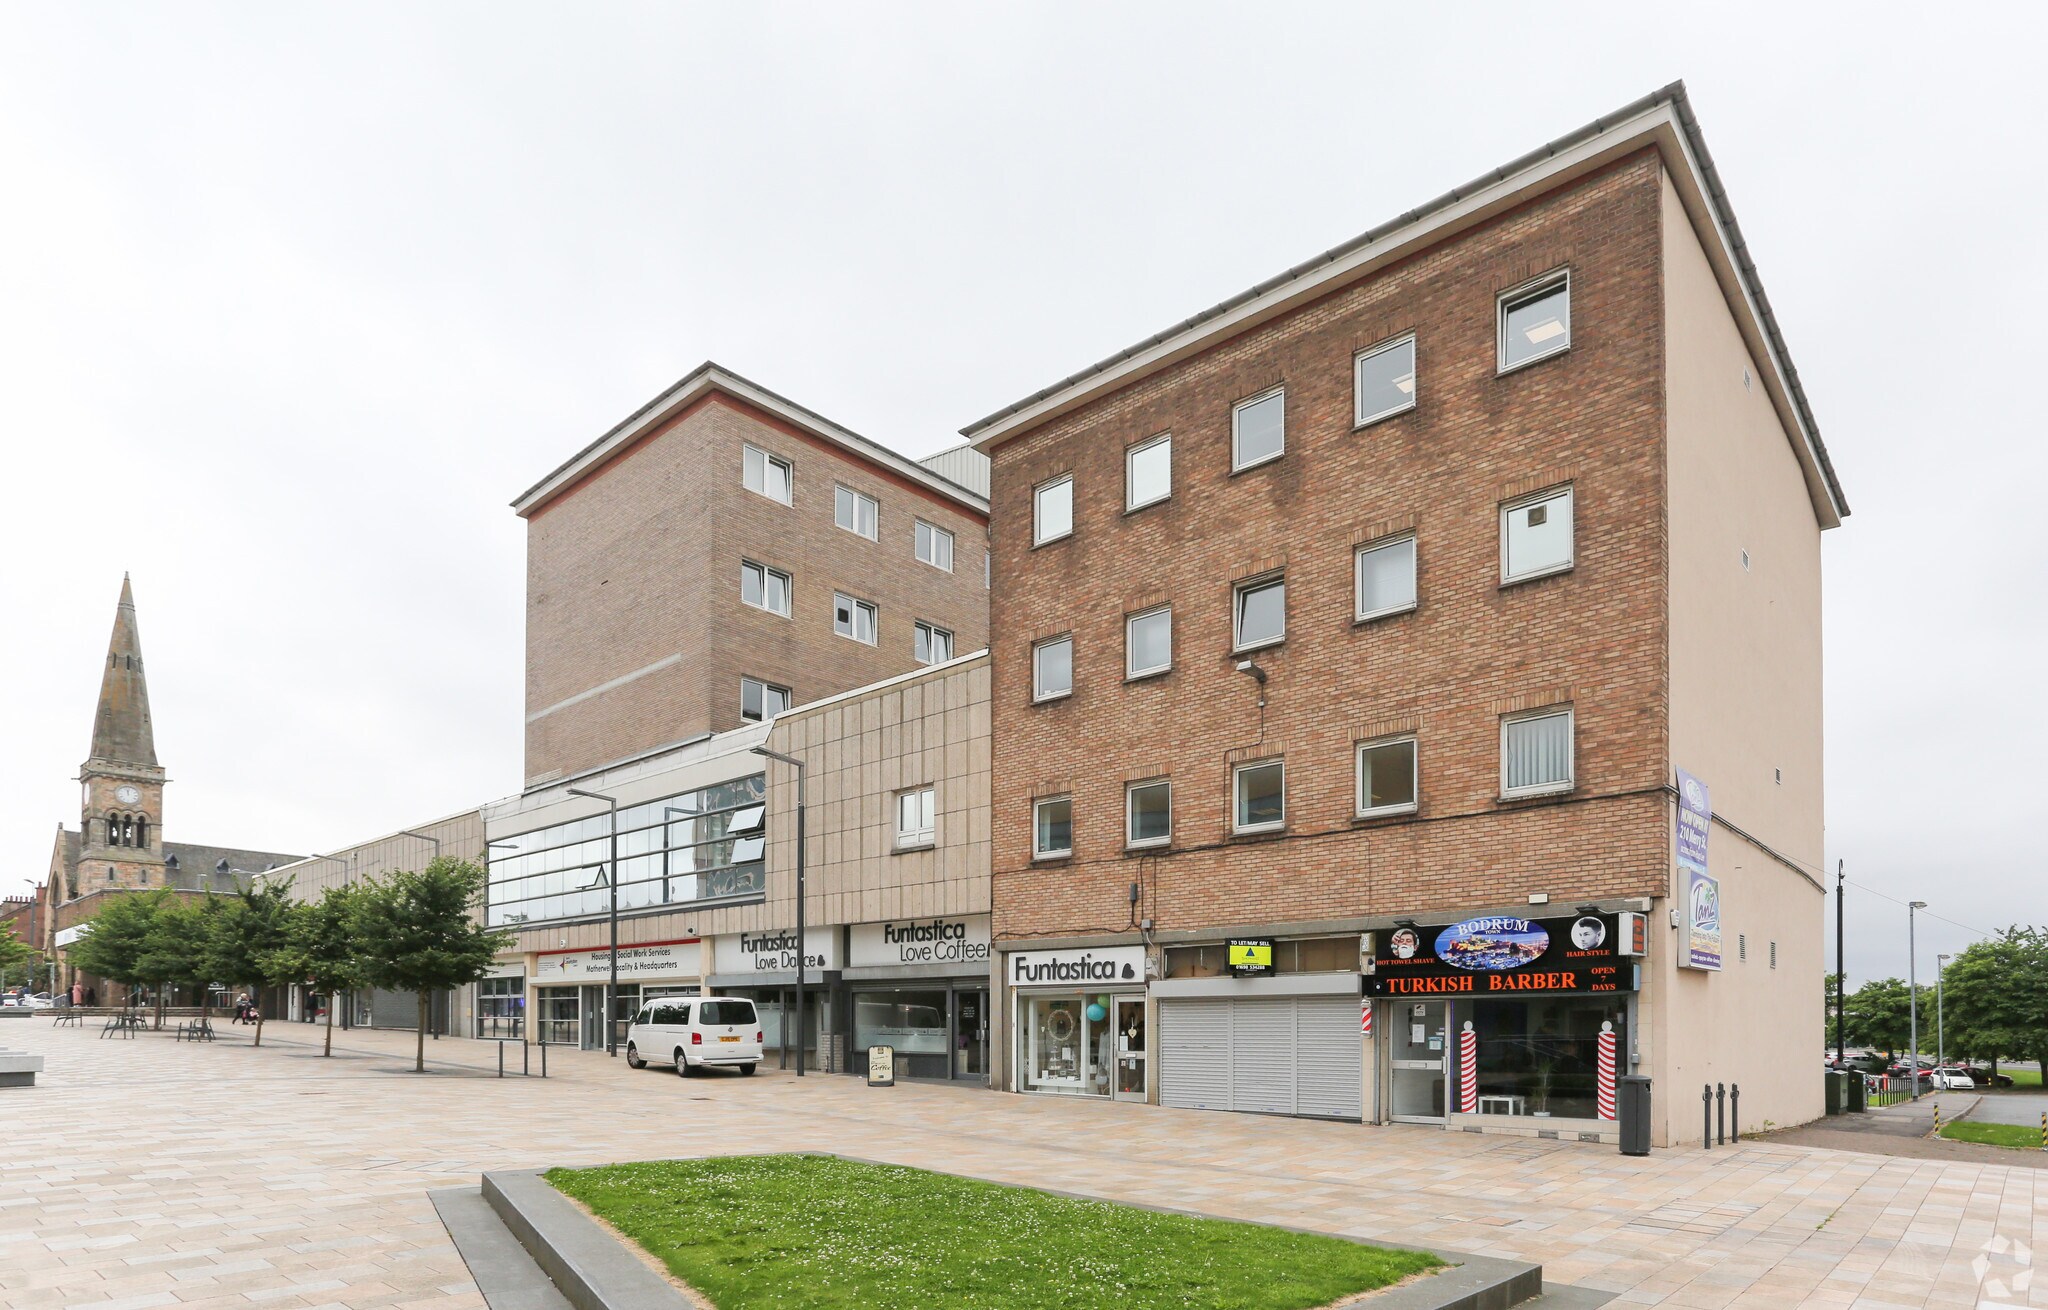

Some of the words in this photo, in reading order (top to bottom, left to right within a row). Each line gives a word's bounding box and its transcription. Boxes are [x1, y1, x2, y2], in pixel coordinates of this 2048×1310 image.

[885, 920, 966, 944] Funtastica
[1457, 918, 1530, 936] BODRUM
[591, 952, 611, 961] Housing
[617, 950, 632, 959] Social
[633, 949, 647, 957] Work
[648, 948, 671, 957] Services
[900, 944, 932, 961] Love
[934, 940, 987, 960] Coffee
[1587, 949, 1610, 957] STYLE
[586, 963, 612, 972] Motherwel
[616, 962, 633, 972] ocality
[634, 962, 638, 970] &
[640, 960, 678, 971] Headquarters
[755, 953, 777, 969] Love
[781, 951, 816, 968] Dace
[1015, 953, 1115, 981] Funtastica
[1591, 967, 1616, 975] OPEN
[1387, 976, 1474, 993] TURKISH
[1488, 972, 1577, 991] BARBER
